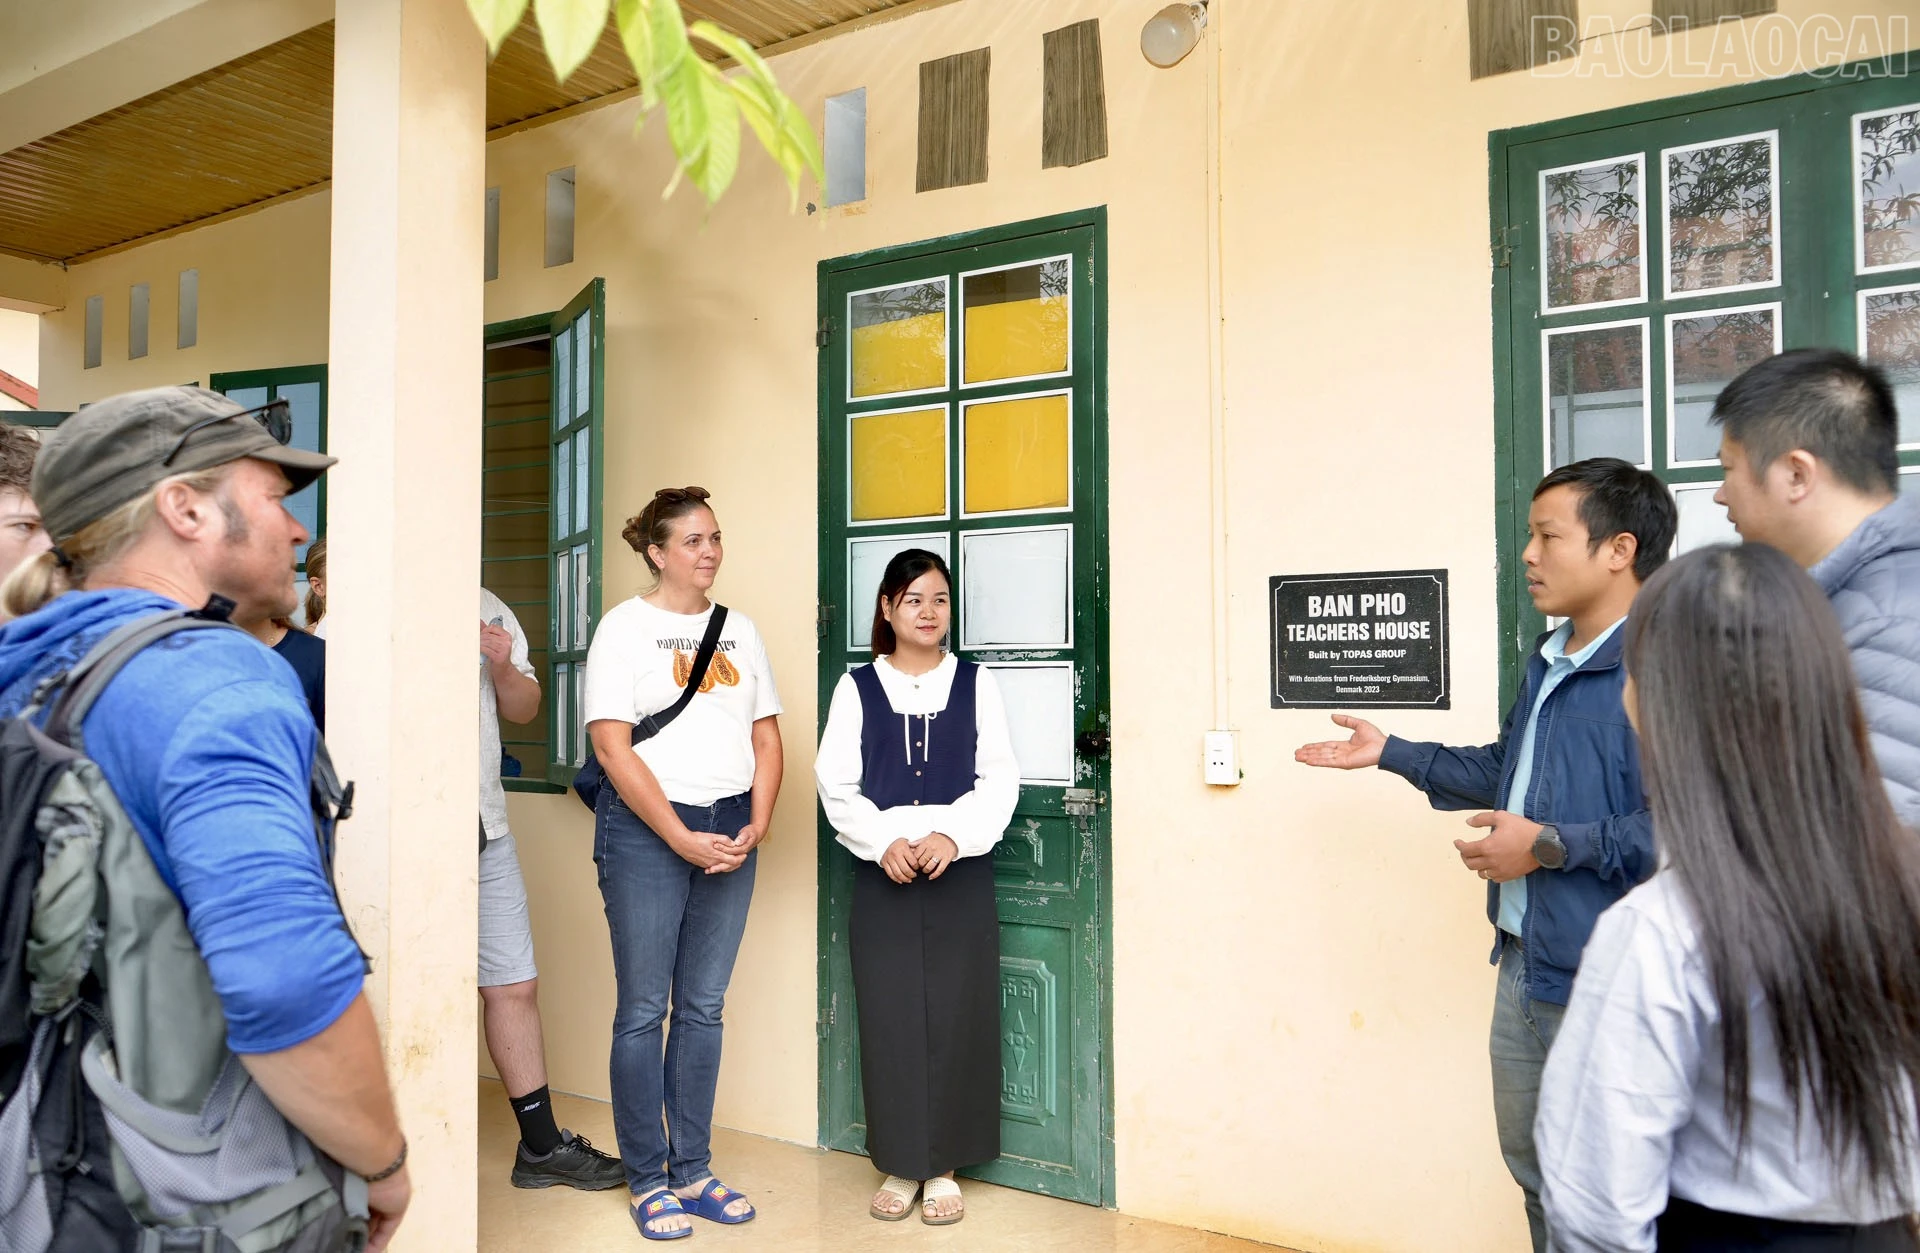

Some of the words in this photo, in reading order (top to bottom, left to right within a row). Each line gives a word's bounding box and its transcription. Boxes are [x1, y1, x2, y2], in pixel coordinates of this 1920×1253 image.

[1308, 594, 1353, 617] BAN
[1361, 593, 1406, 616] PHO
[1287, 623, 1370, 641] TEACHERS
[1375, 621, 1430, 640] HOUSE
[656, 638, 692, 650] PAPAYA
[1309, 650, 1328, 659] Built
[1330, 651, 1340, 660] by
[1343, 650, 1372, 658] TOPAS
[1375, 649, 1406, 658] GROUP
[1350, 674, 1391, 683] Frederiksborg
